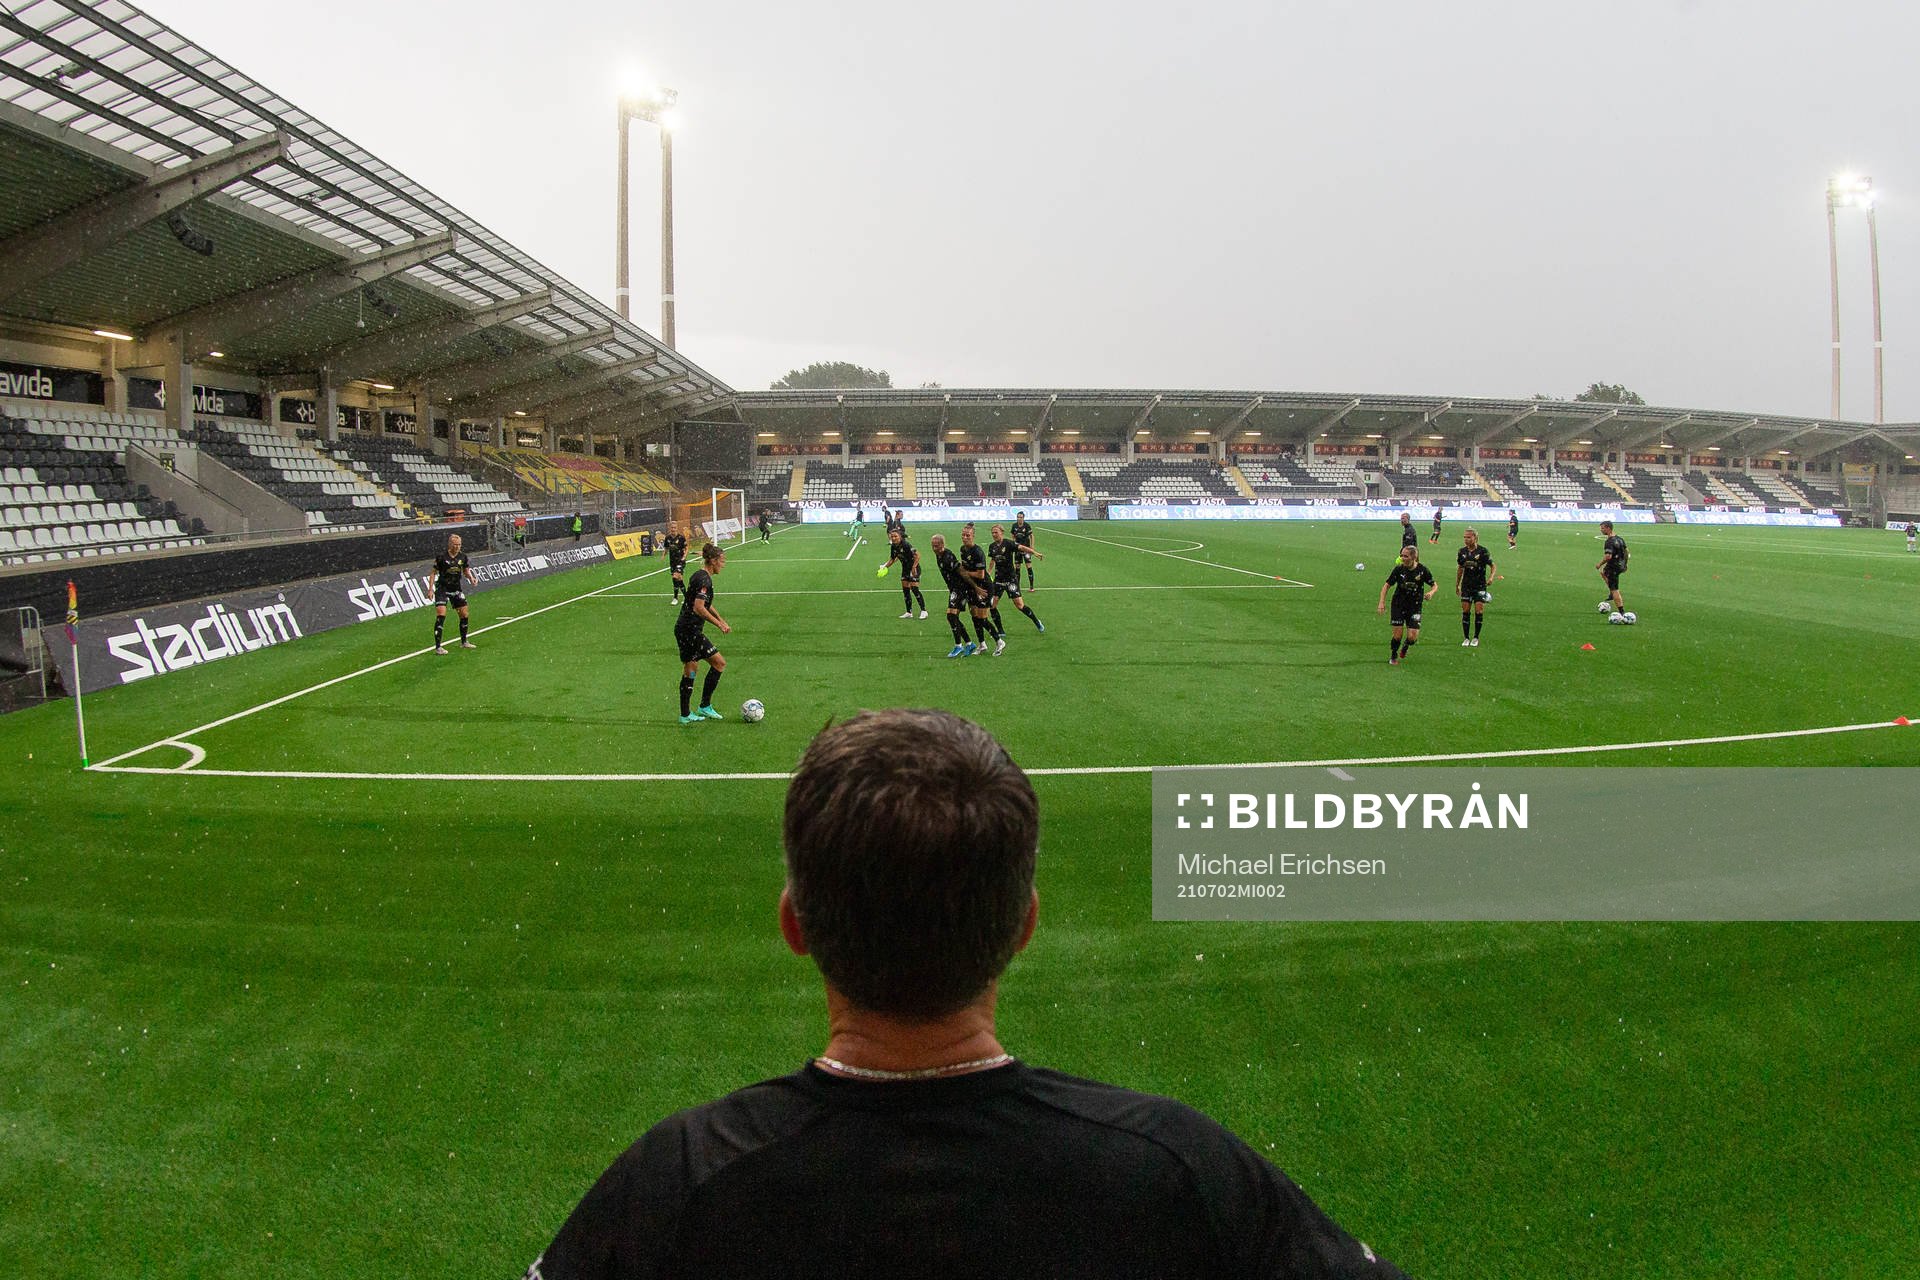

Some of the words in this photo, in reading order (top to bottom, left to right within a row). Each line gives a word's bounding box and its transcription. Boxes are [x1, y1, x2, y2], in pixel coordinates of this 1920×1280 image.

[799, 501, 826, 509] RASTA
[860, 500, 887, 508] RASTA
[982, 499, 1010, 507] RASTA
[1041, 499, 1069, 507] RASTA
[1140, 498, 1168, 506] RASTA
[1200, 498, 1226, 506] RASTA
[1257, 498, 1283, 506] RASTA
[1366, 499, 1391, 507] RASTA
[1408, 499, 1432, 507] RASTA
[1459, 500, 1483, 508] RASTA
[1509, 501, 1531, 509] RASTA
[1556, 502, 1578, 510] RASTA
[1600, 502, 1621, 510] RASTA
[1032, 510, 1069, 519] OBOS
[1132, 509, 1168, 518] OBOS
[108, 603, 303, 684] stadium
